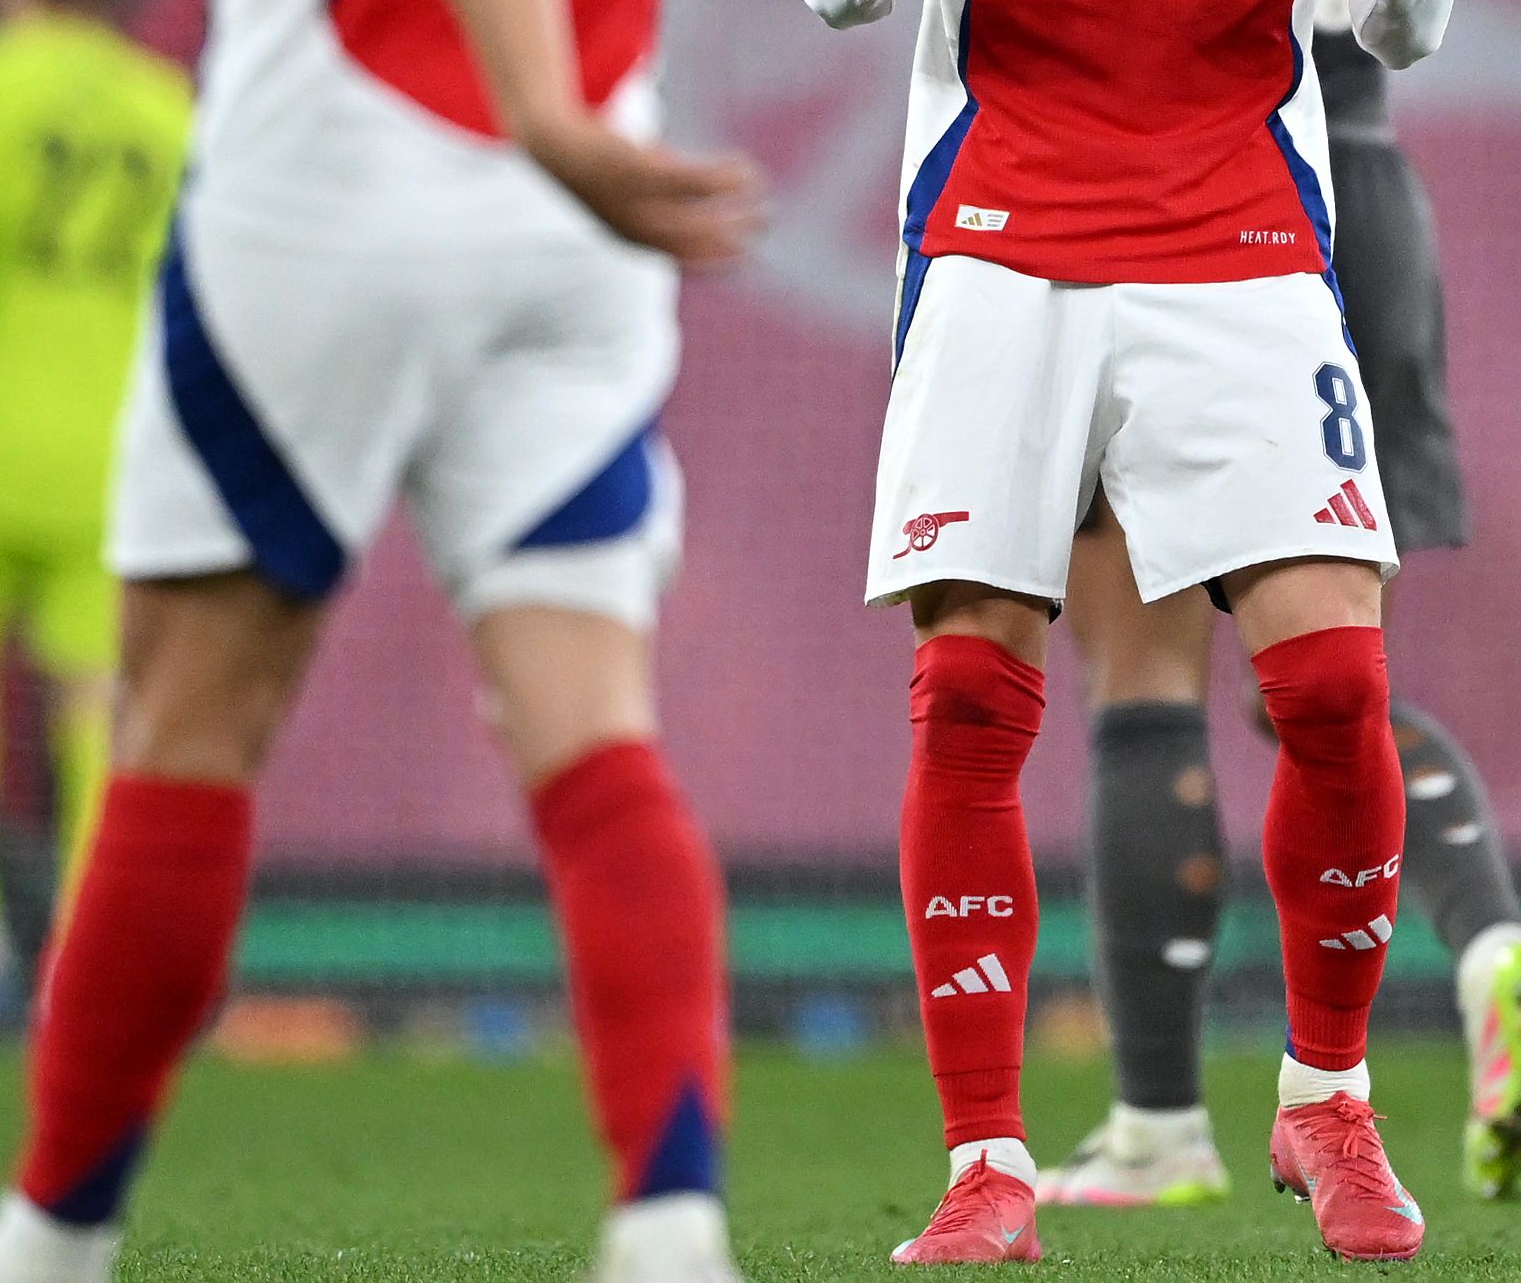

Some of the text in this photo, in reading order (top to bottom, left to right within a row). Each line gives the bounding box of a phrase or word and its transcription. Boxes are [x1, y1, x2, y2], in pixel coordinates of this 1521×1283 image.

[1239, 229, 1297, 246] HEAT.RDY
[1312, 361, 1368, 474] 8
[1319, 853, 1401, 888] AFC
[925, 894, 1015, 920] AFC
